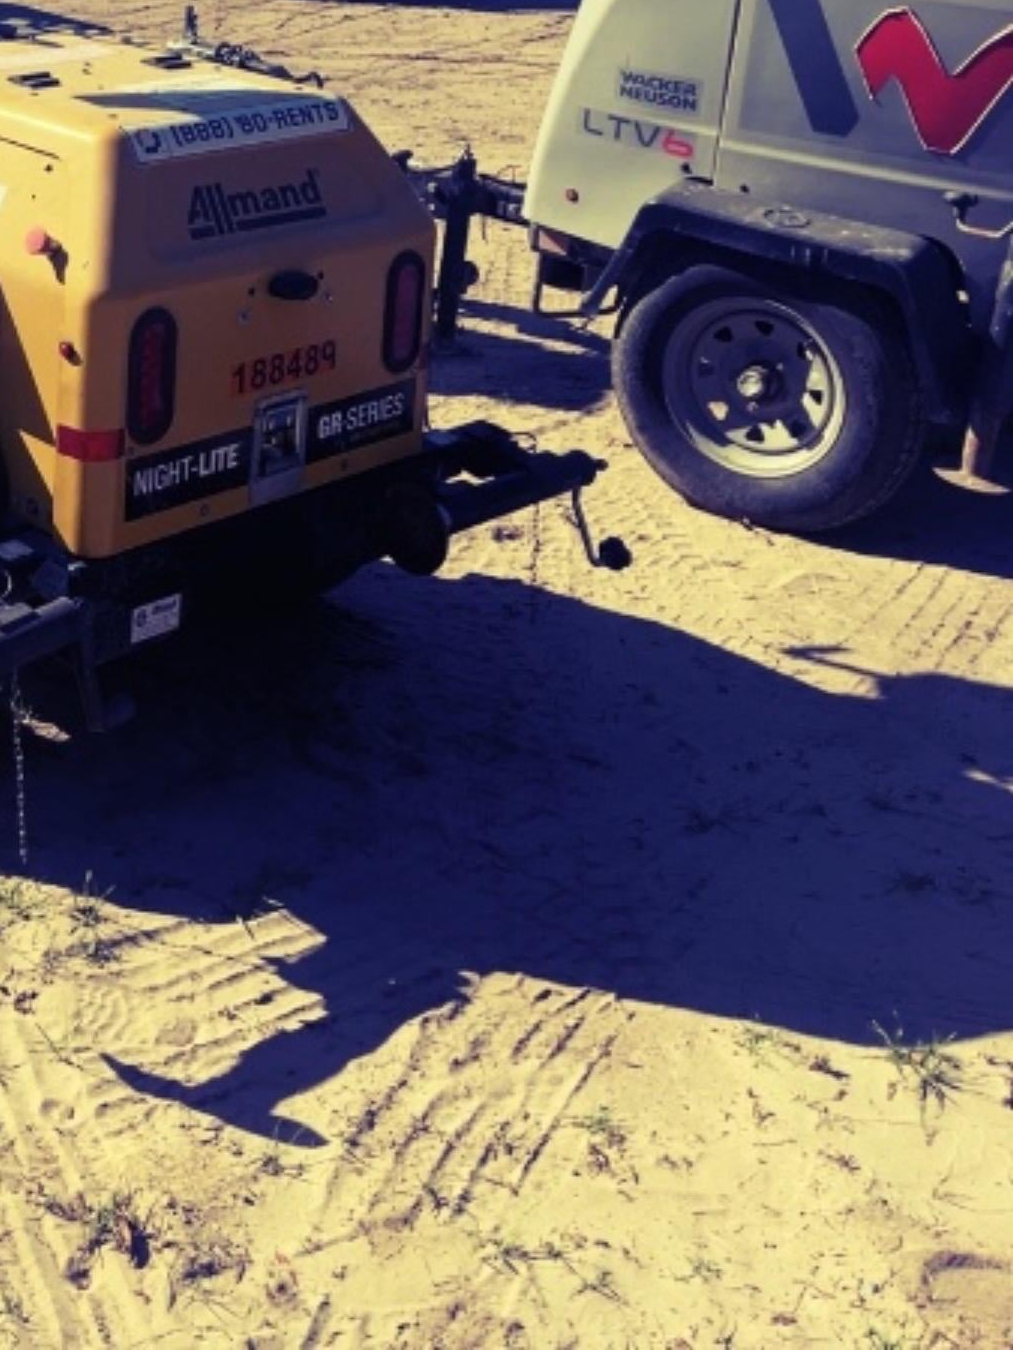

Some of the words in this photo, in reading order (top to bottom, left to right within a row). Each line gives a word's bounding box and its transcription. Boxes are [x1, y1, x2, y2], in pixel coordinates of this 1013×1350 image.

[620, 70, 696, 96] WACKER
[620, 86, 696, 111] NEUSON
[584, 109, 693, 158] LTV6
[188, 169, 322, 236] Allmand
[233, 340, 336, 394] 188489
[134, 444, 239, 496] NIGHT-LITE
